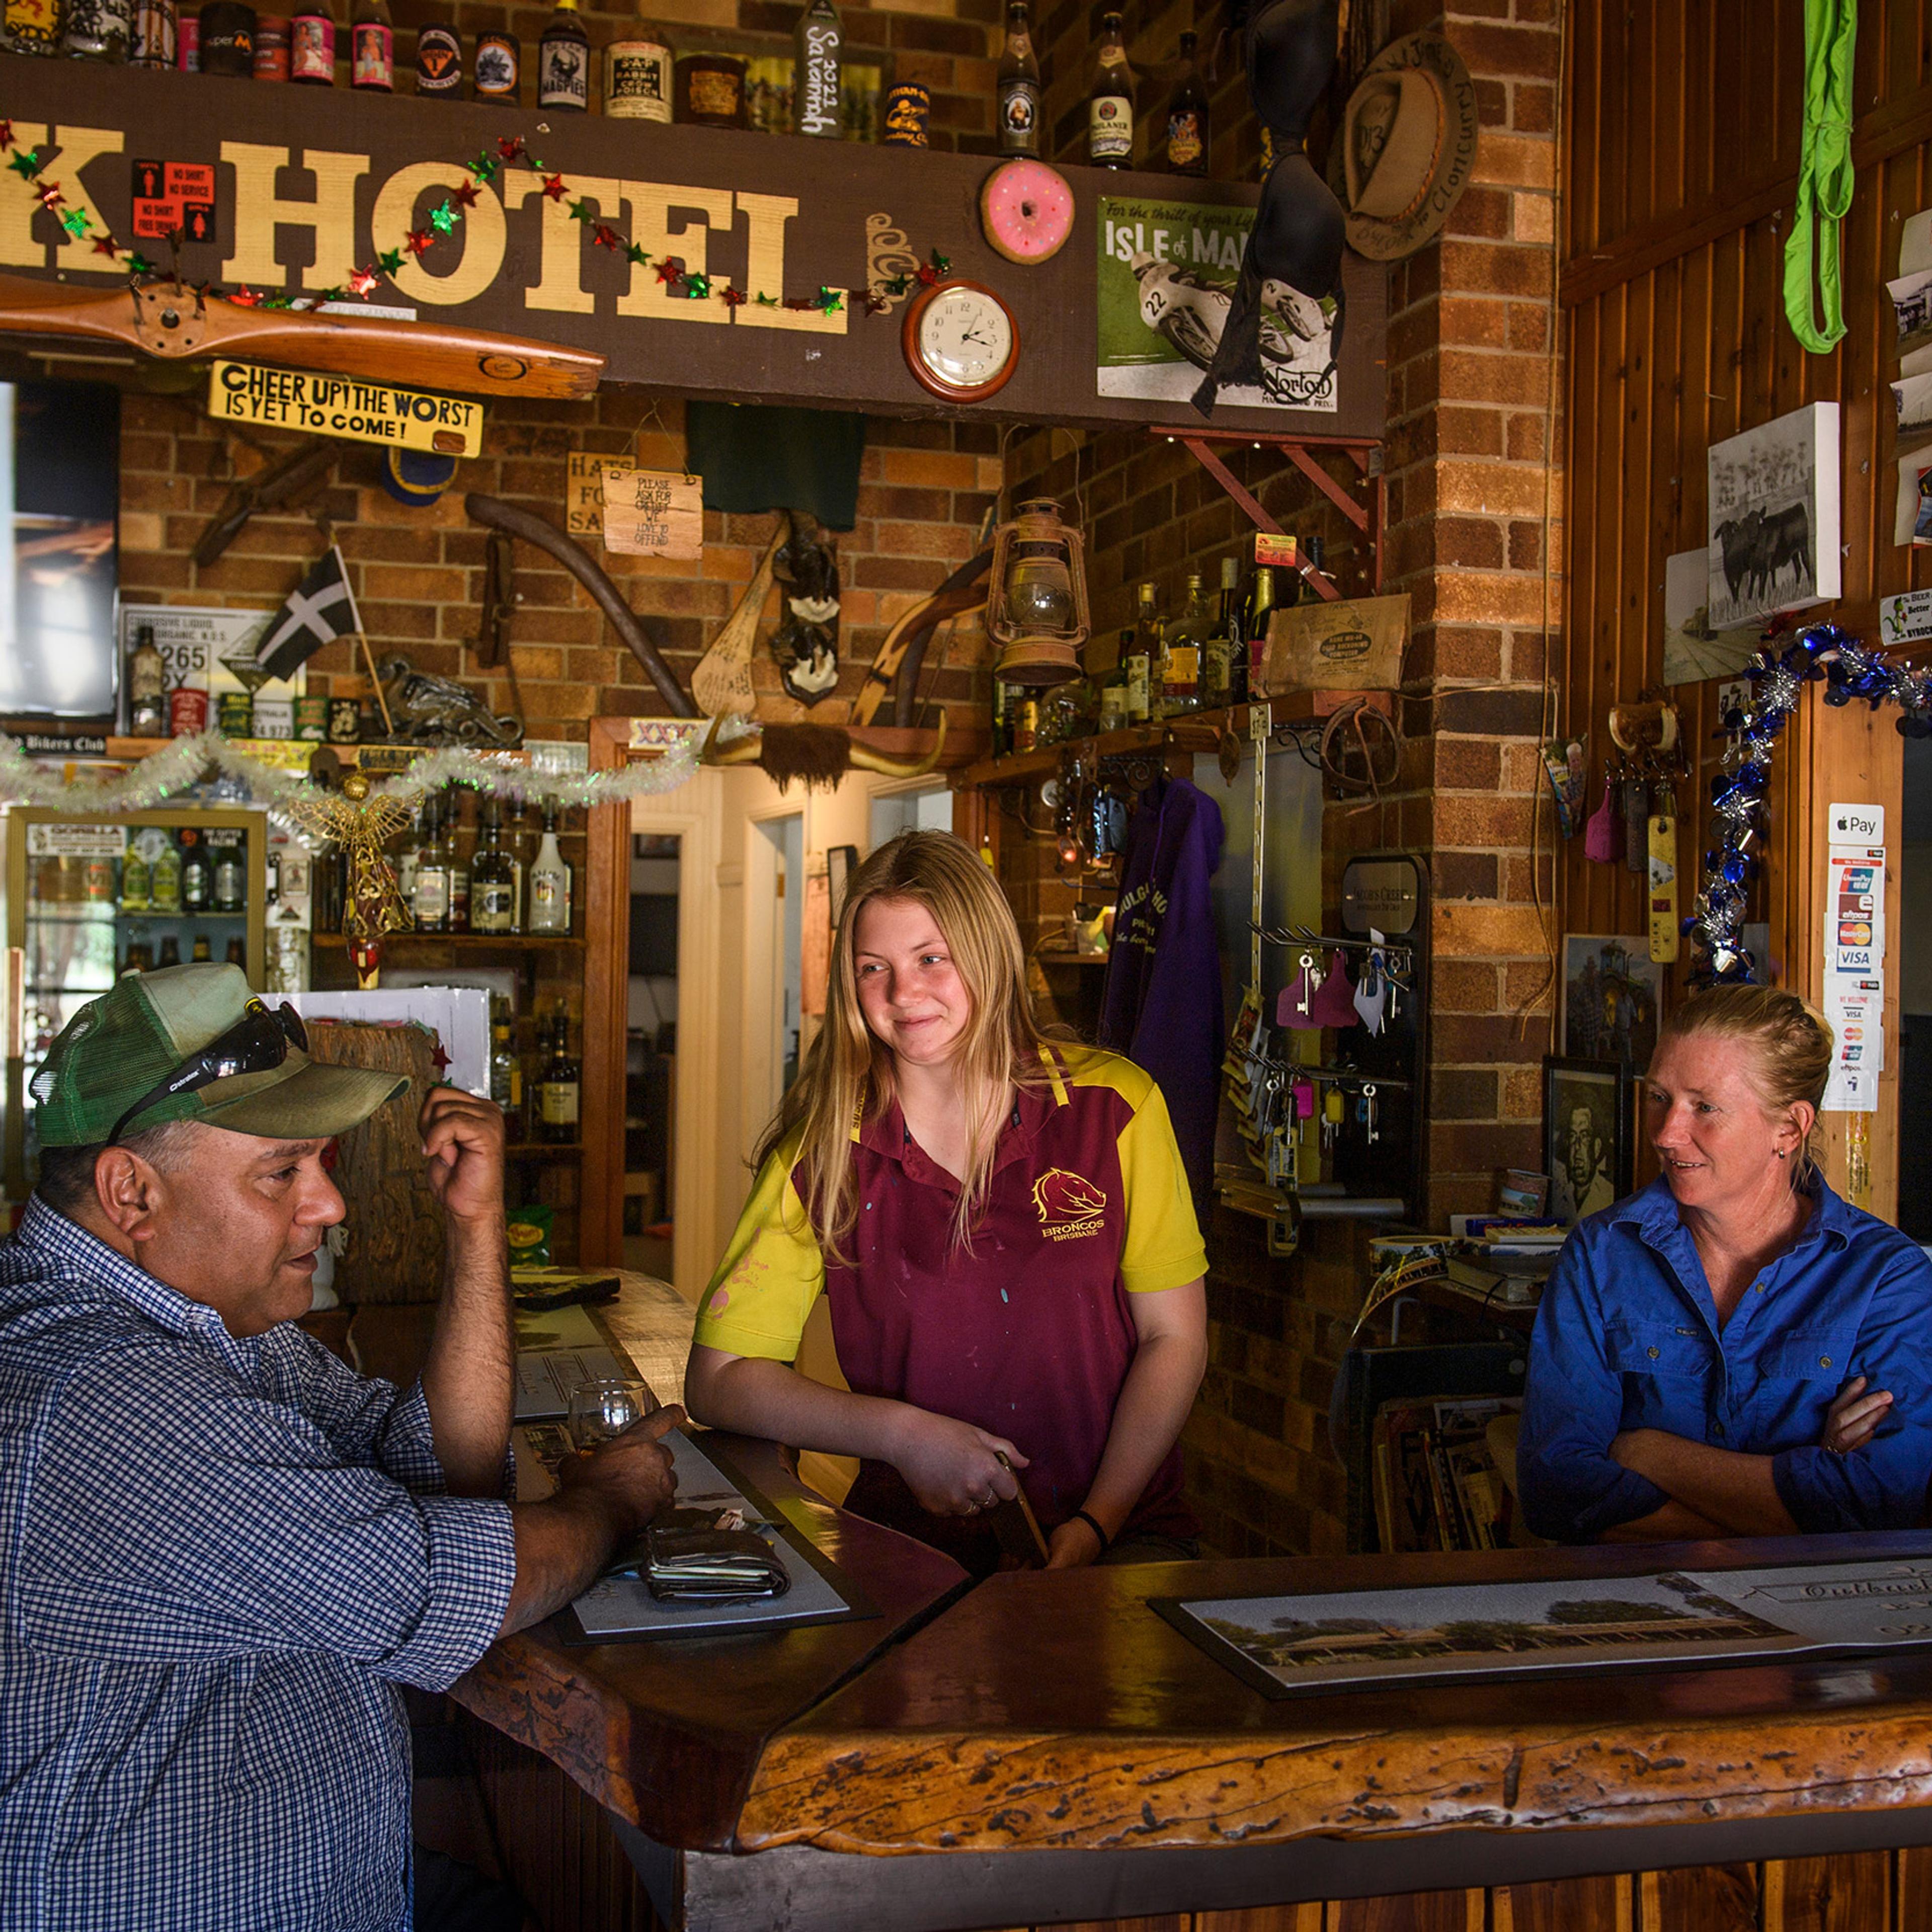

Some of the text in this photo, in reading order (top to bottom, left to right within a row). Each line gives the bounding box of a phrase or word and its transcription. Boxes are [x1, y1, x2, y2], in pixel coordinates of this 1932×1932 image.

[615, 70, 658, 81] RABBIT
[620, 79, 653, 88] CROW
[823, 59, 839, 109] 2021
[616, 87, 659, 97] POISON
[173, 168, 205, 181] NO SHIRT
[169, 183, 209, 197] NO SERVICE
[142, 204, 152, 215] NO
[1107, 203, 1126, 217] For
[1129, 204, 1148, 219] the
[1151, 205, 1185, 222] thrill
[220, 140, 848, 334] HOTEL
[1106, 220, 1169, 264] ISLE
[959, 302, 971, 313] 12
[1146, 291, 1167, 317] 22
[934, 316, 944, 328] 10
[1263, 366, 1333, 405] Norton
[220, 364, 474, 428] CHEER UP! THE WORST
[225, 392, 244, 416] IS
[250, 395, 291, 422] YET
[298, 403, 326, 427] TO
[637, 477, 671, 490] PLEASE
[581, 487, 604, 505] FO
[635, 490, 671, 504] ASK FOR
[570, 511, 601, 530] SA
[645, 511, 660, 523] WE
[634, 534, 669, 547] OFFEND
[1911, 592, 1930, 602] BEER
[1908, 605, 1930, 614] Better
[160, 645, 205, 670] 265
[26, 735, 72, 750] Bikers
[73, 736, 106, 751] Club
[1850, 817, 1876, 835] Pay
[1843, 873, 1872, 884] UnionPay
[1842, 910, 1870, 920] eftpos
[1841, 951, 1870, 964] VISA
[1041, 1219, 1105, 1238] BRONCOS
[1053, 1229, 1098, 1242] BRISBANE
